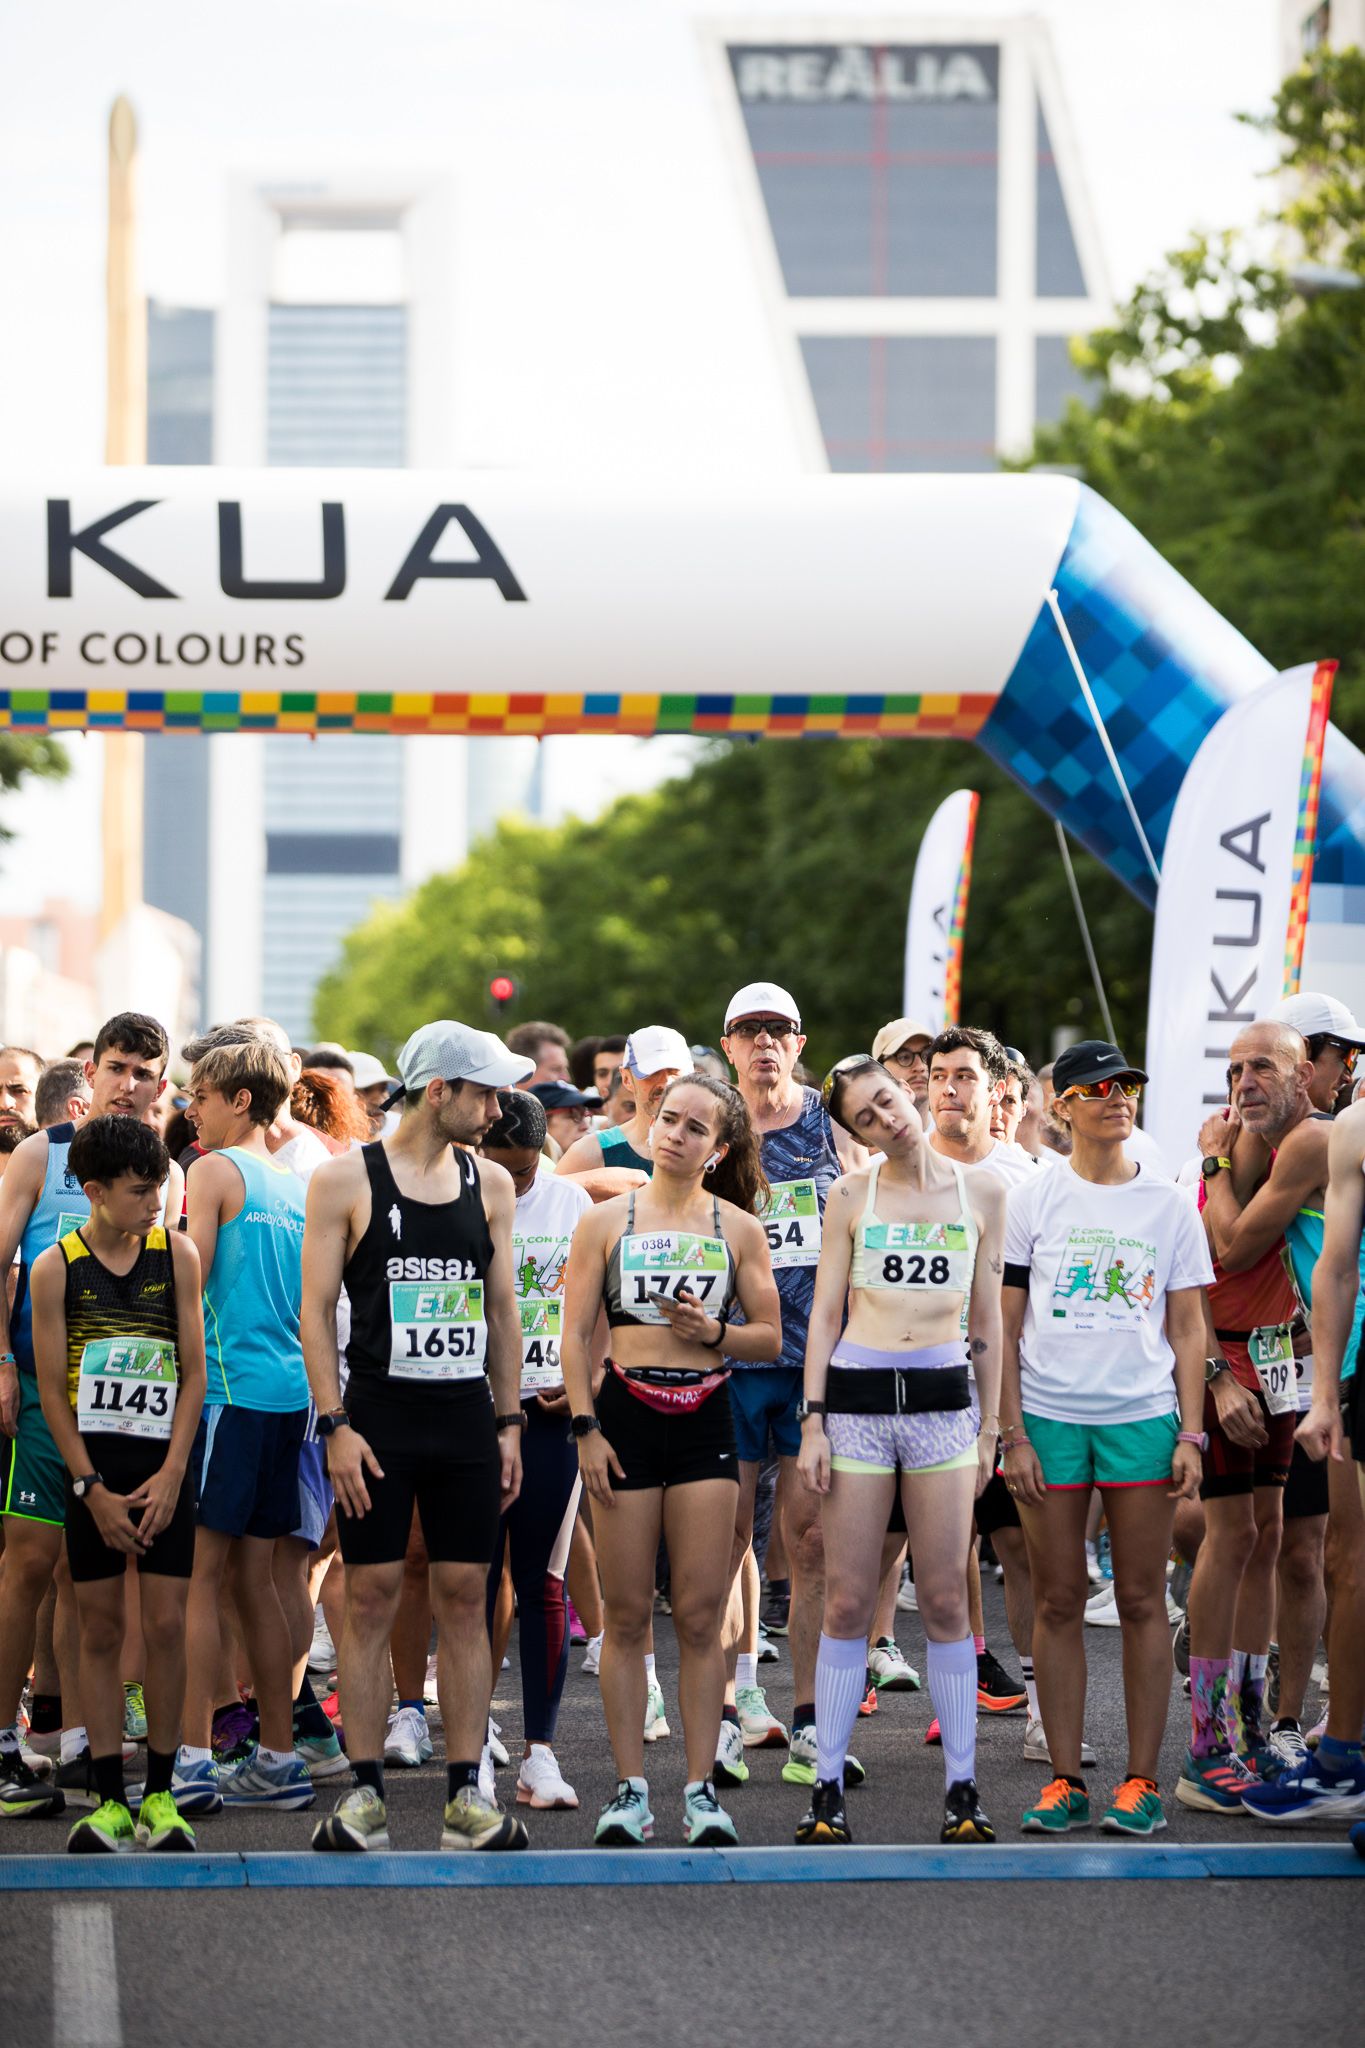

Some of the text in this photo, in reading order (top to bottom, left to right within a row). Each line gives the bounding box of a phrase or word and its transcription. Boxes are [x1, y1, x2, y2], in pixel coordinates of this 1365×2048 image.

[739, 47, 990, 98] REALIA
[47, 499, 529, 602] KUA
[0, 632, 305, 666] OF COLOURS
[527, 1236, 553, 1244] CON
[642, 1238, 672, 1251] 0384
[886, 1222, 947, 1247] ELA
[1067, 1235, 1116, 1245] MADRID
[1119, 1237, 1144, 1249] CON
[882, 1254, 950, 1285] 828
[415, 1291, 470, 1319] ELA
[633, 1275, 717, 1304] 1767
[406, 1326, 476, 1358] 1651
[104, 1346, 164, 1377] ELA
[90, 1380, 168, 1416] 1143
